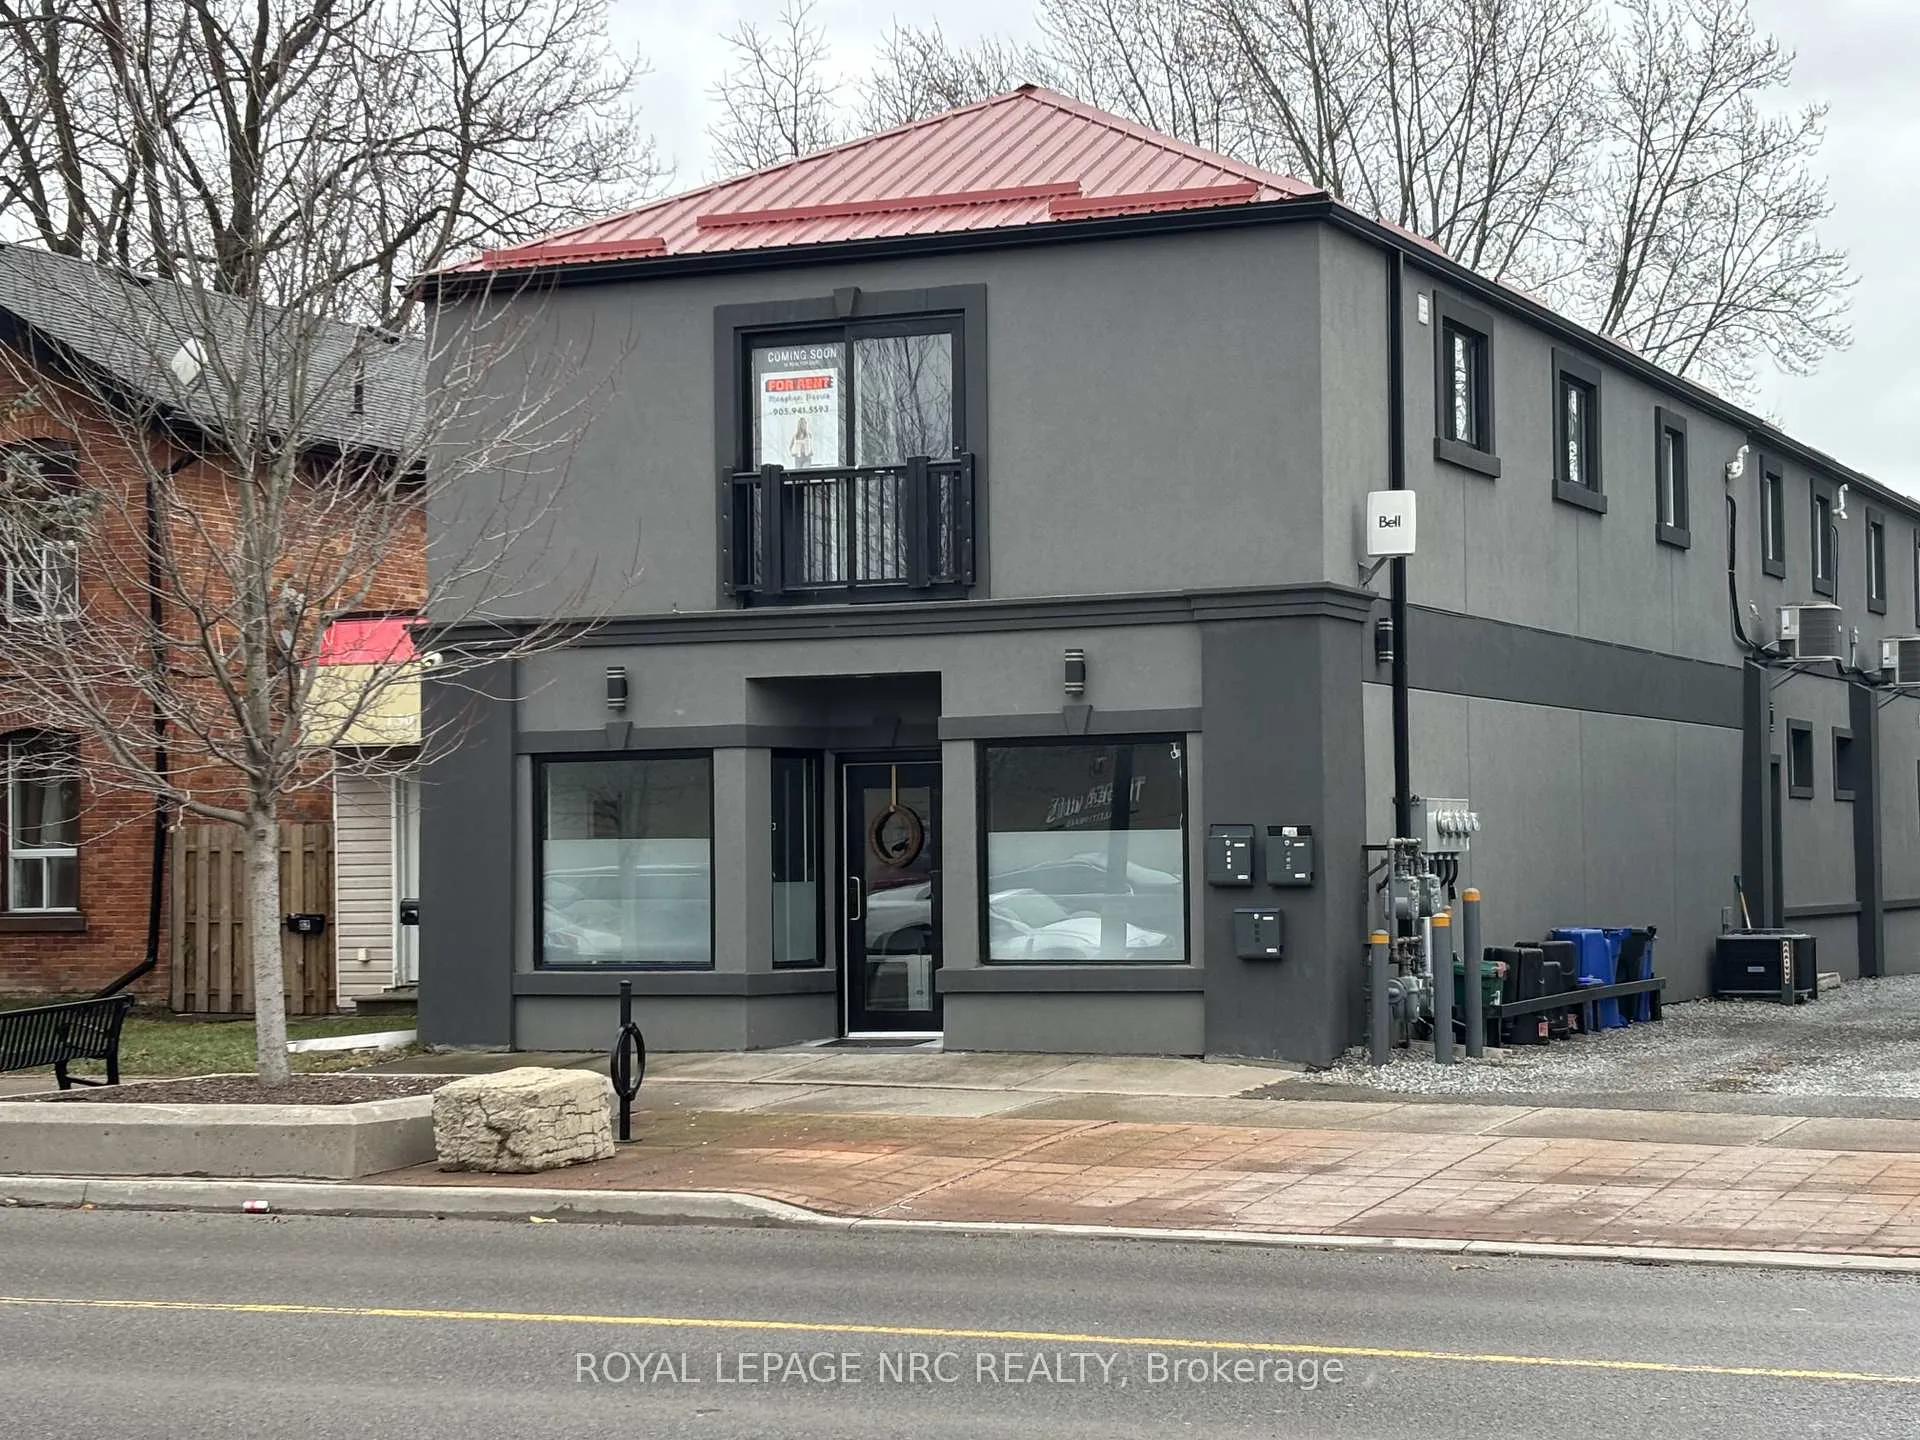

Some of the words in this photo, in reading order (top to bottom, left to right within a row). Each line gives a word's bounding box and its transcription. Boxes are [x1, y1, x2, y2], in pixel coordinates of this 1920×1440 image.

[767, 350, 807, 363] COMING
[810, 348, 837, 360] SOON
[767, 379, 794, 391] FOR
[797, 377, 830, 390] RENT
[1379, 515, 1401, 528] Bell
